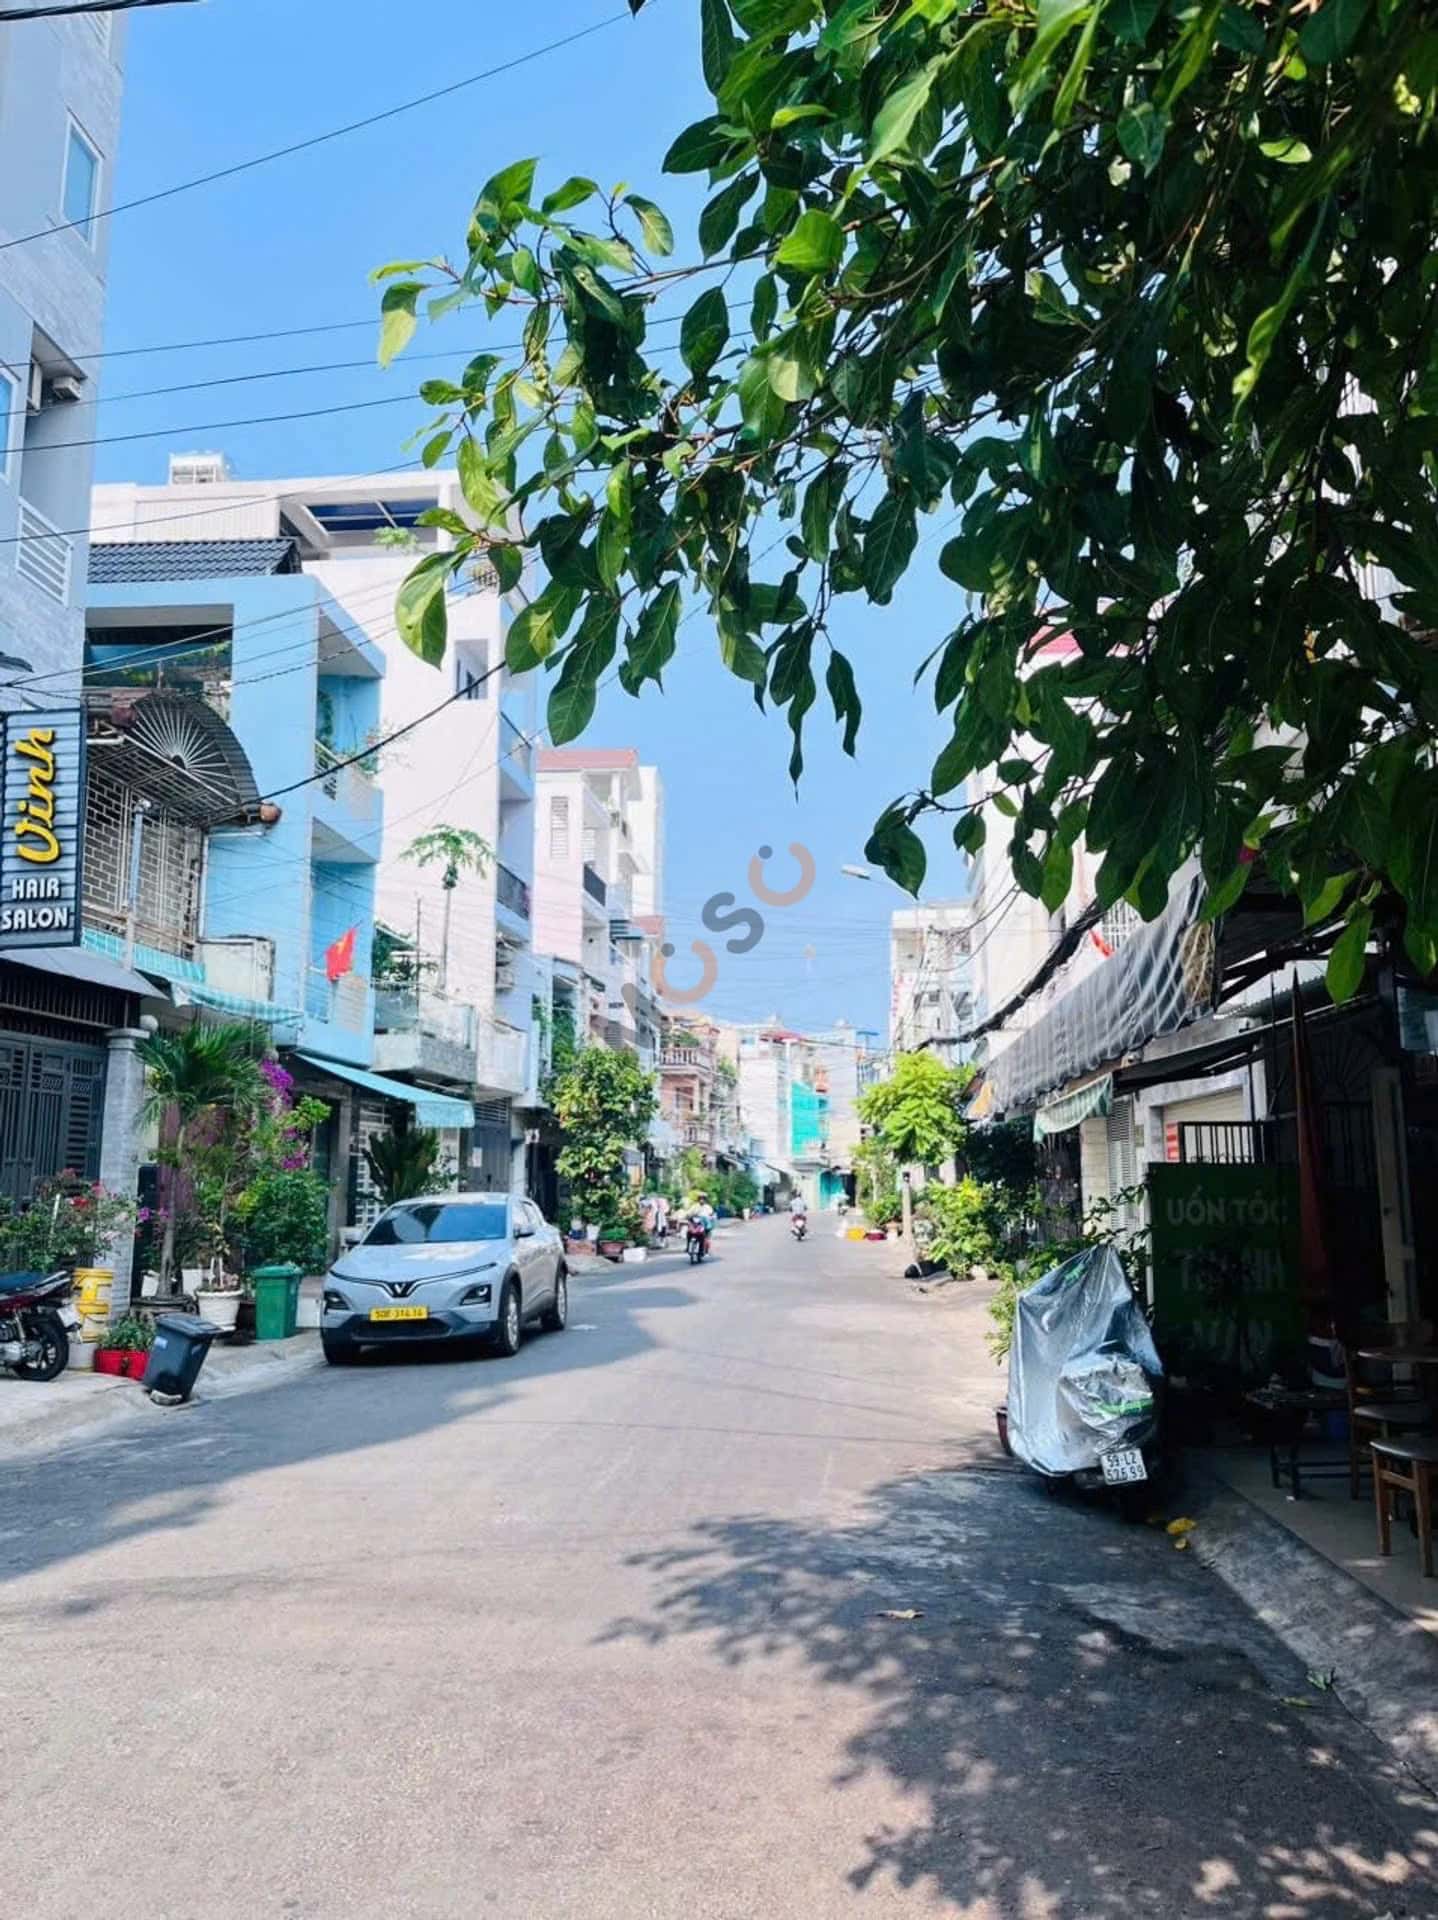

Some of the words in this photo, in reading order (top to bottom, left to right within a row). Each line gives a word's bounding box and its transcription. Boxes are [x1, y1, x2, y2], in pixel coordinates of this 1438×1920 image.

[15, 728, 61, 863] Vinh
[12, 876, 61, 899] HAIR
[2, 906, 69, 930] SALON
